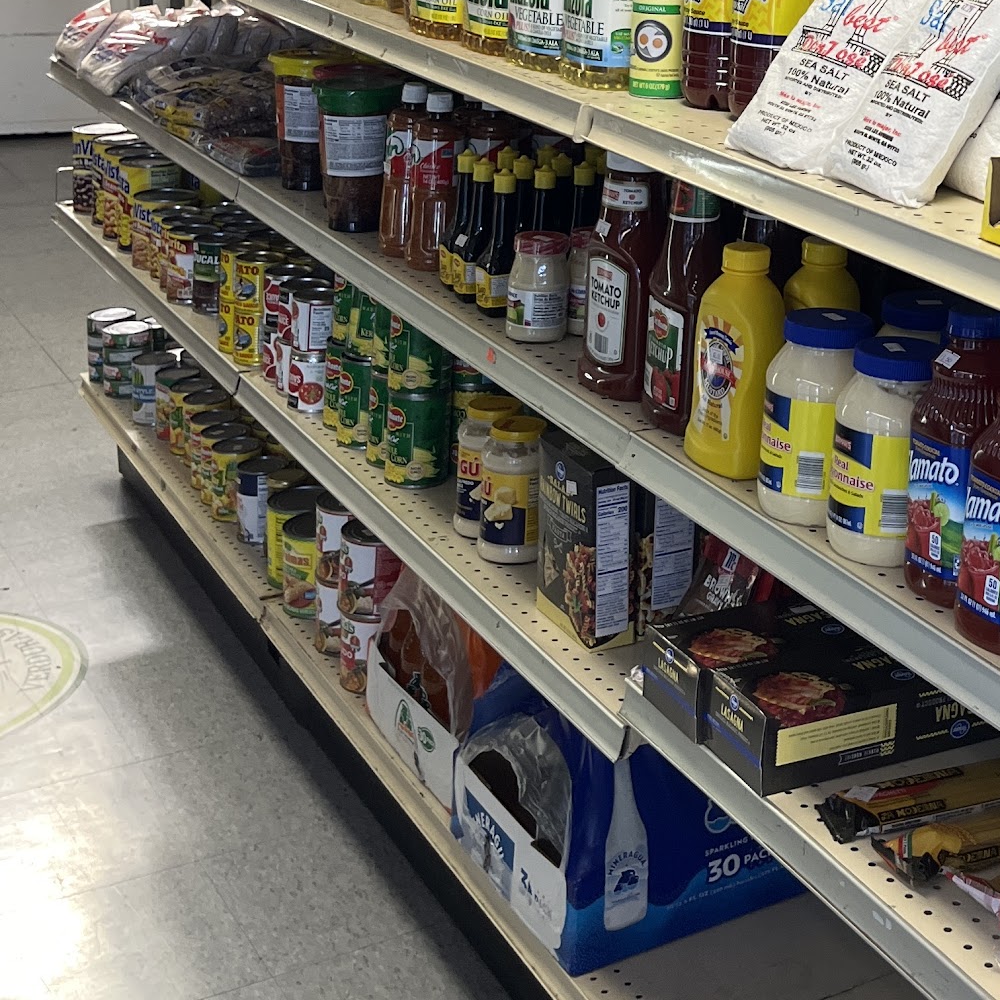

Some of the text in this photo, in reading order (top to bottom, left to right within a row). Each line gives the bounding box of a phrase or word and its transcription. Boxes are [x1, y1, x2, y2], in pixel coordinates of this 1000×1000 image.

[514, 6, 564, 27] VEGETABLE
[843, 4, 891, 33] best
[787, 67, 850, 96] 100% Natural
[799, 57, 851, 82] SEA SALT
[884, 79, 932, 103] SEA SALT
[874, 90, 931, 120] 100% Natural
[846, 139, 898, 167] PRODUCT MEXICO
[591, 276, 622, 298] TOMATO
[591, 289, 621, 310] KETCHUP
[833, 454, 849, 471] Real
[908, 451, 960, 485] lamato
[561, 498, 587, 525] TWIRLS
[987, 578, 998, 590] 50
[657, 657, 679, 683] LASAGNA
[720, 702, 744, 733] LASAGNA
[704, 836, 750, 857] SPARKLING
[607, 851, 648, 877] MINERAGUA
[707, 853, 741, 884] 30
